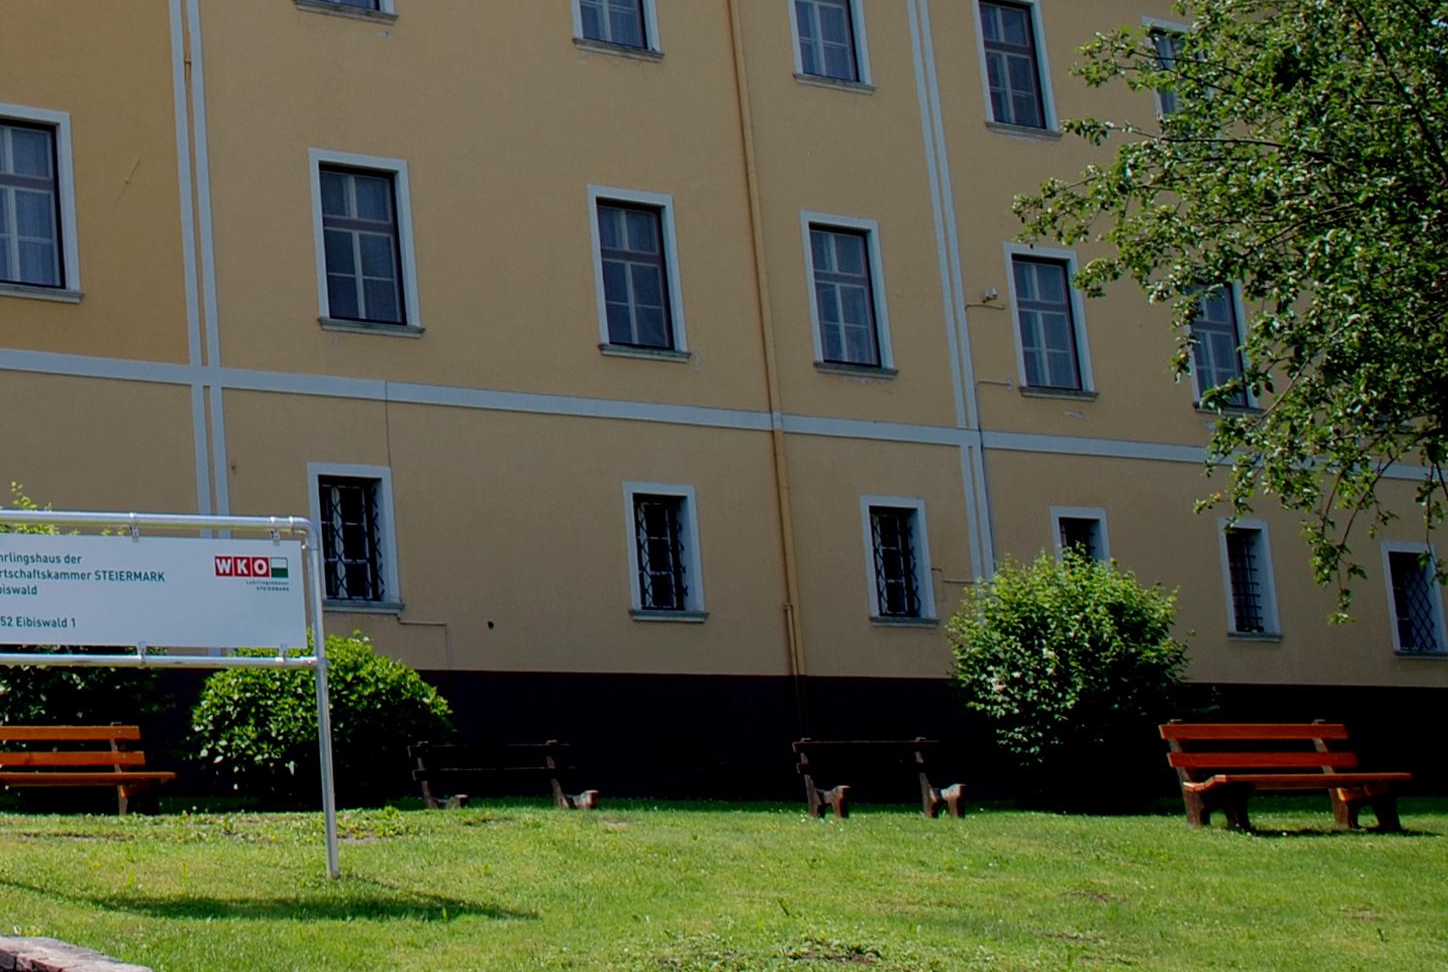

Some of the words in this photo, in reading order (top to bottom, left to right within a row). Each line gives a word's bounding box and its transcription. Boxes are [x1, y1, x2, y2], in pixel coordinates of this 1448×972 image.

[63, 553, 83, 565] der
[216, 558, 269, 576] WKO
[94, 569, 166, 583] STEIERMARK
[15, 615, 68, 629] Eibiswald
[70, 617, 76, 629] 1
